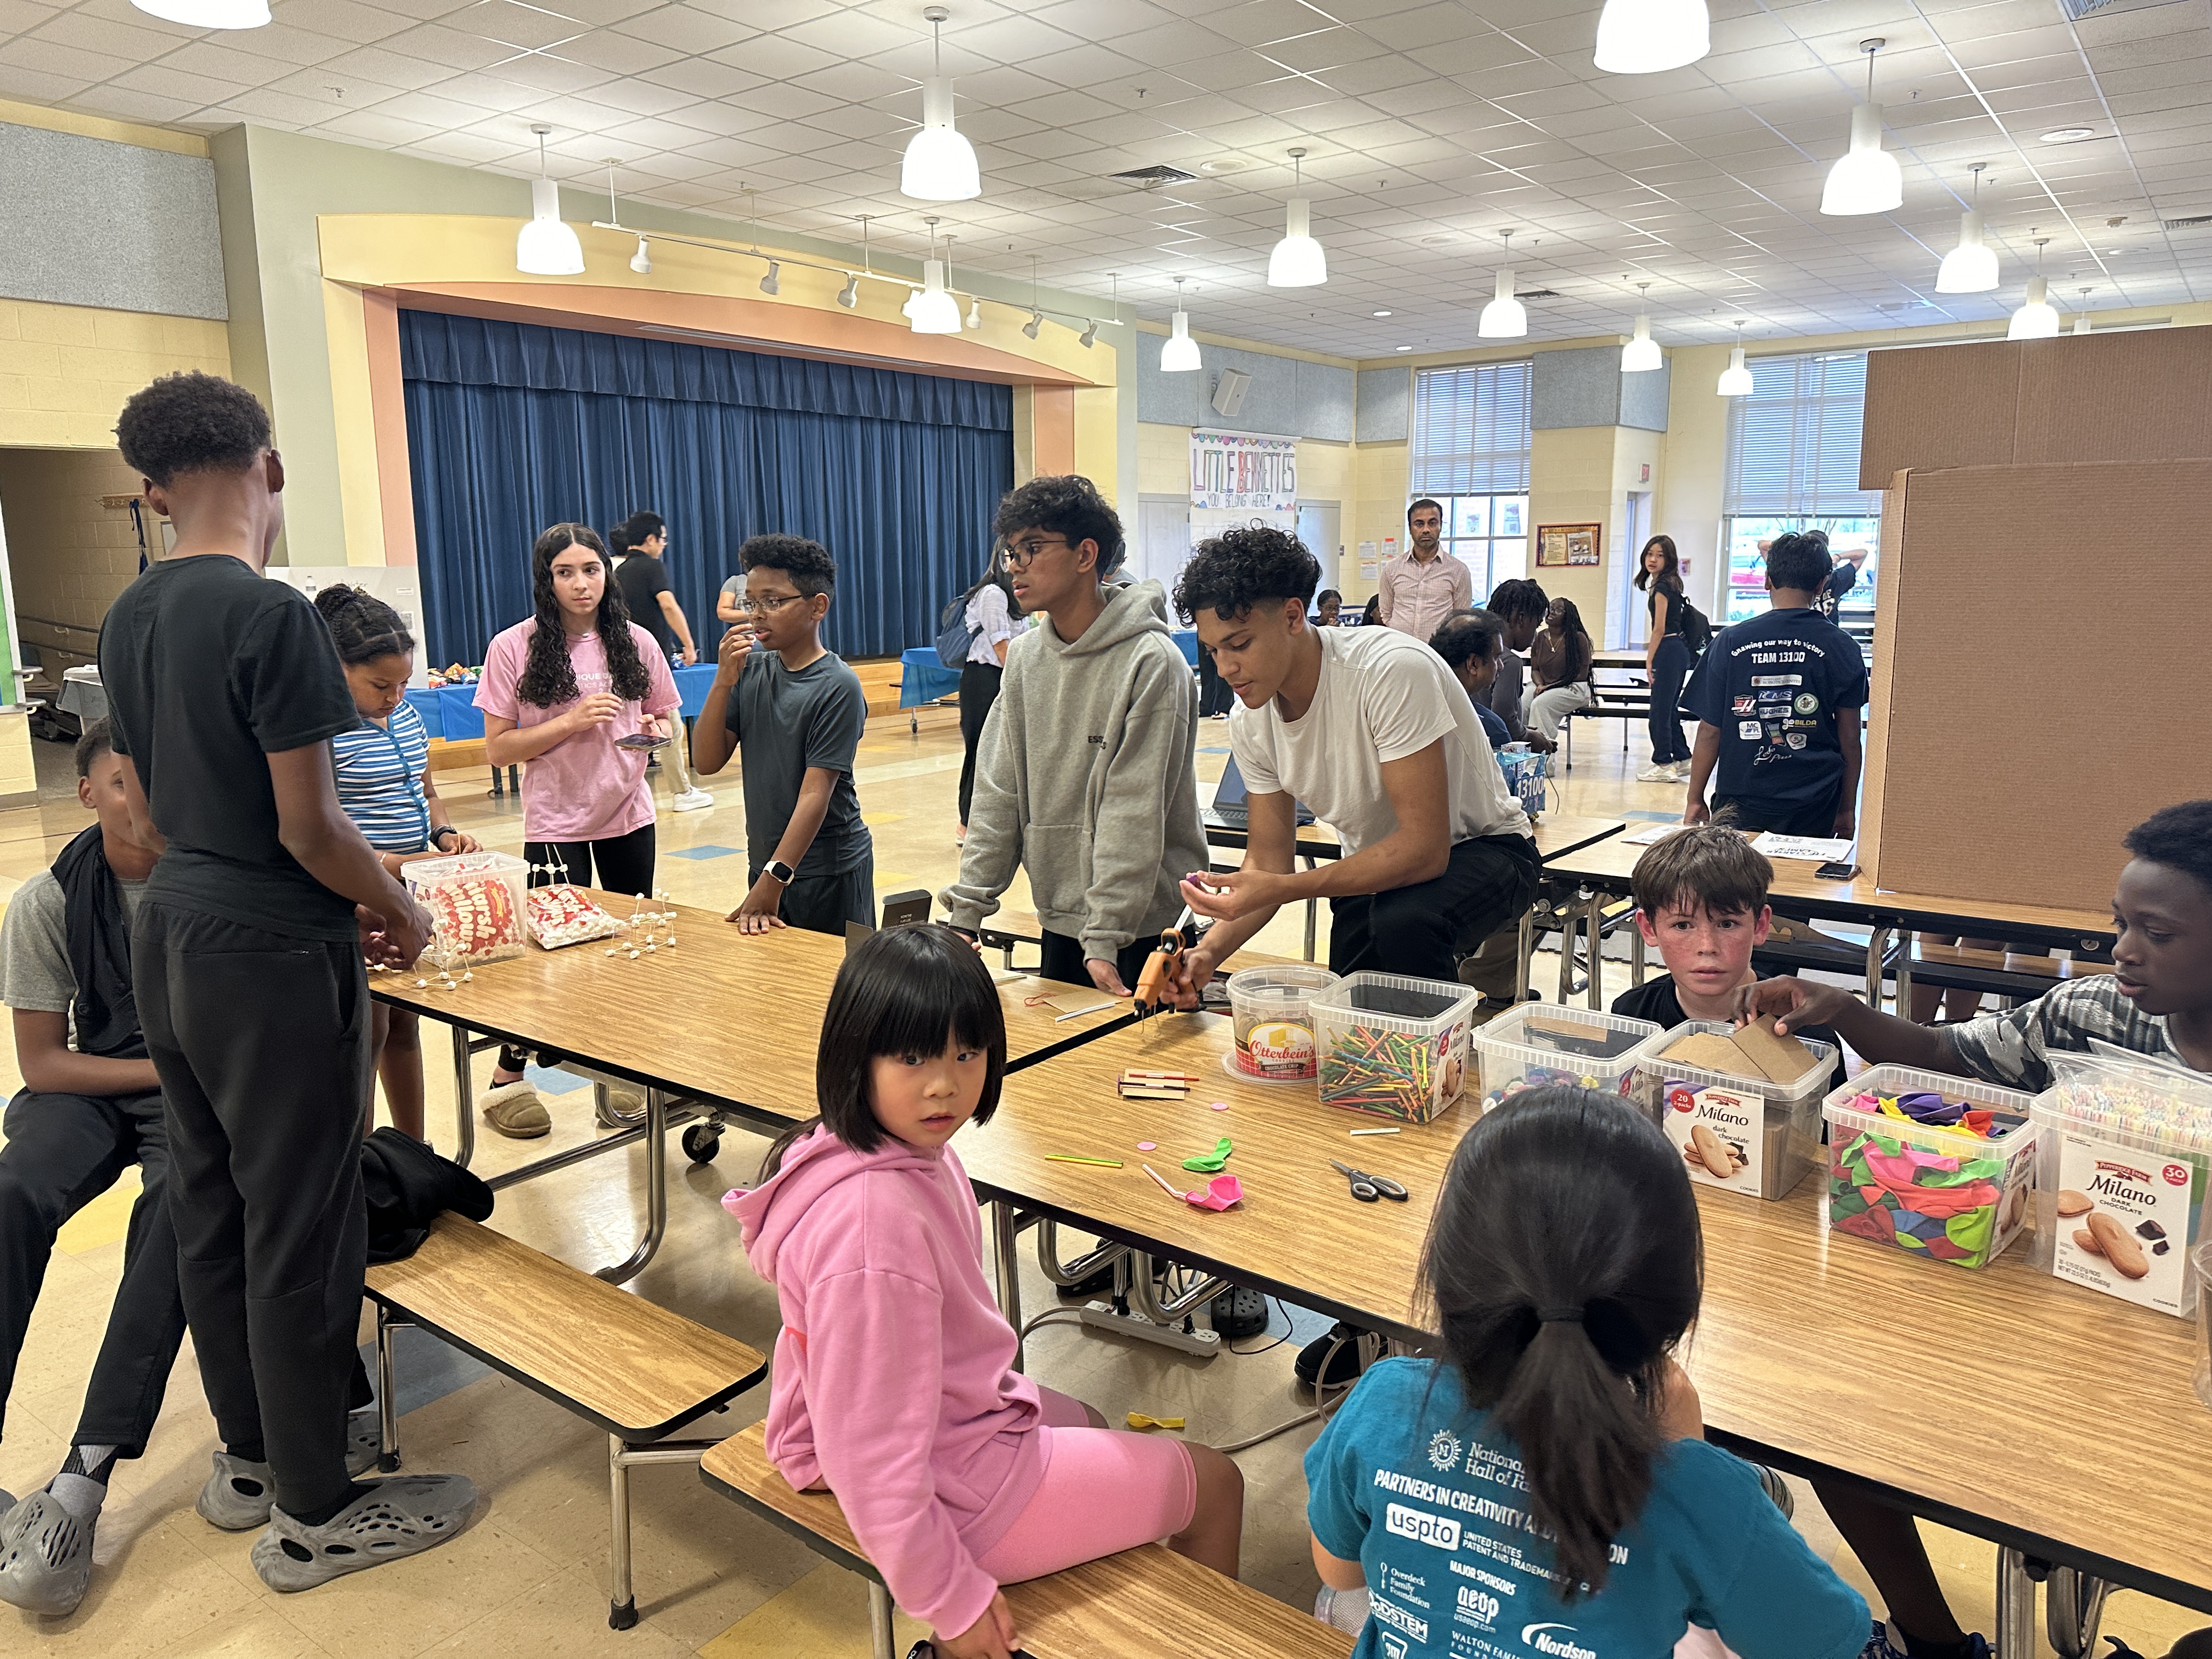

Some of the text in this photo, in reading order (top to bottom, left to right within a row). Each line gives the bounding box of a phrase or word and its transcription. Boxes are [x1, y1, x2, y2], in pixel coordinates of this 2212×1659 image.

[1193, 449, 1235, 493] LITTLE
[1207, 493, 1271, 507] YOU BELONG HERE!
[1731, 641, 1762, 657] Gnawing
[1803, 641, 1825, 657] victory
[1751, 652, 1776, 664] TEAM
[1250, 1040, 1314, 1059] Otterbein's
[1674, 1101, 1691, 1109] 2-packs
[1677, 1094, 1688, 1103] 20
[1695, 1104, 1748, 1126] Milano
[1713, 1125, 1727, 1133] dark
[1718, 1132, 1750, 1144] chocolate
[2165, 1167, 2185, 1178] 30
[2086, 1175, 2156, 1205] Milano
[2100, 1199, 2142, 1215] CHOCOLATE
[2111, 1198, 2131, 1207] DARK
[1465, 1458, 1532, 1493] Hall of Fa
[1374, 1469, 1436, 1502] PARTNERS
[1436, 1486, 1451, 1506] IN
[1451, 1491, 1525, 1529] CREATIVITY
[1392, 1511, 1453, 1543] uspto
[1462, 1539, 1492, 1557] PATENT
[1492, 1550, 1509, 1564] AND
[1464, 1531, 1522, 1559] UNITED STATES
[1390, 1577, 1415, 1594] Family
[1391, 1568, 1426, 1587] Overdeck
[1449, 1560, 1517, 1596] MAJOR SPONSORS
[1390, 1586, 1431, 1610] Foundation
[1454, 1613, 1496, 1633] usaeop.com
[1452, 1630, 1492, 1652] WALTON
[1535, 1632, 1597, 1659] Nordson
